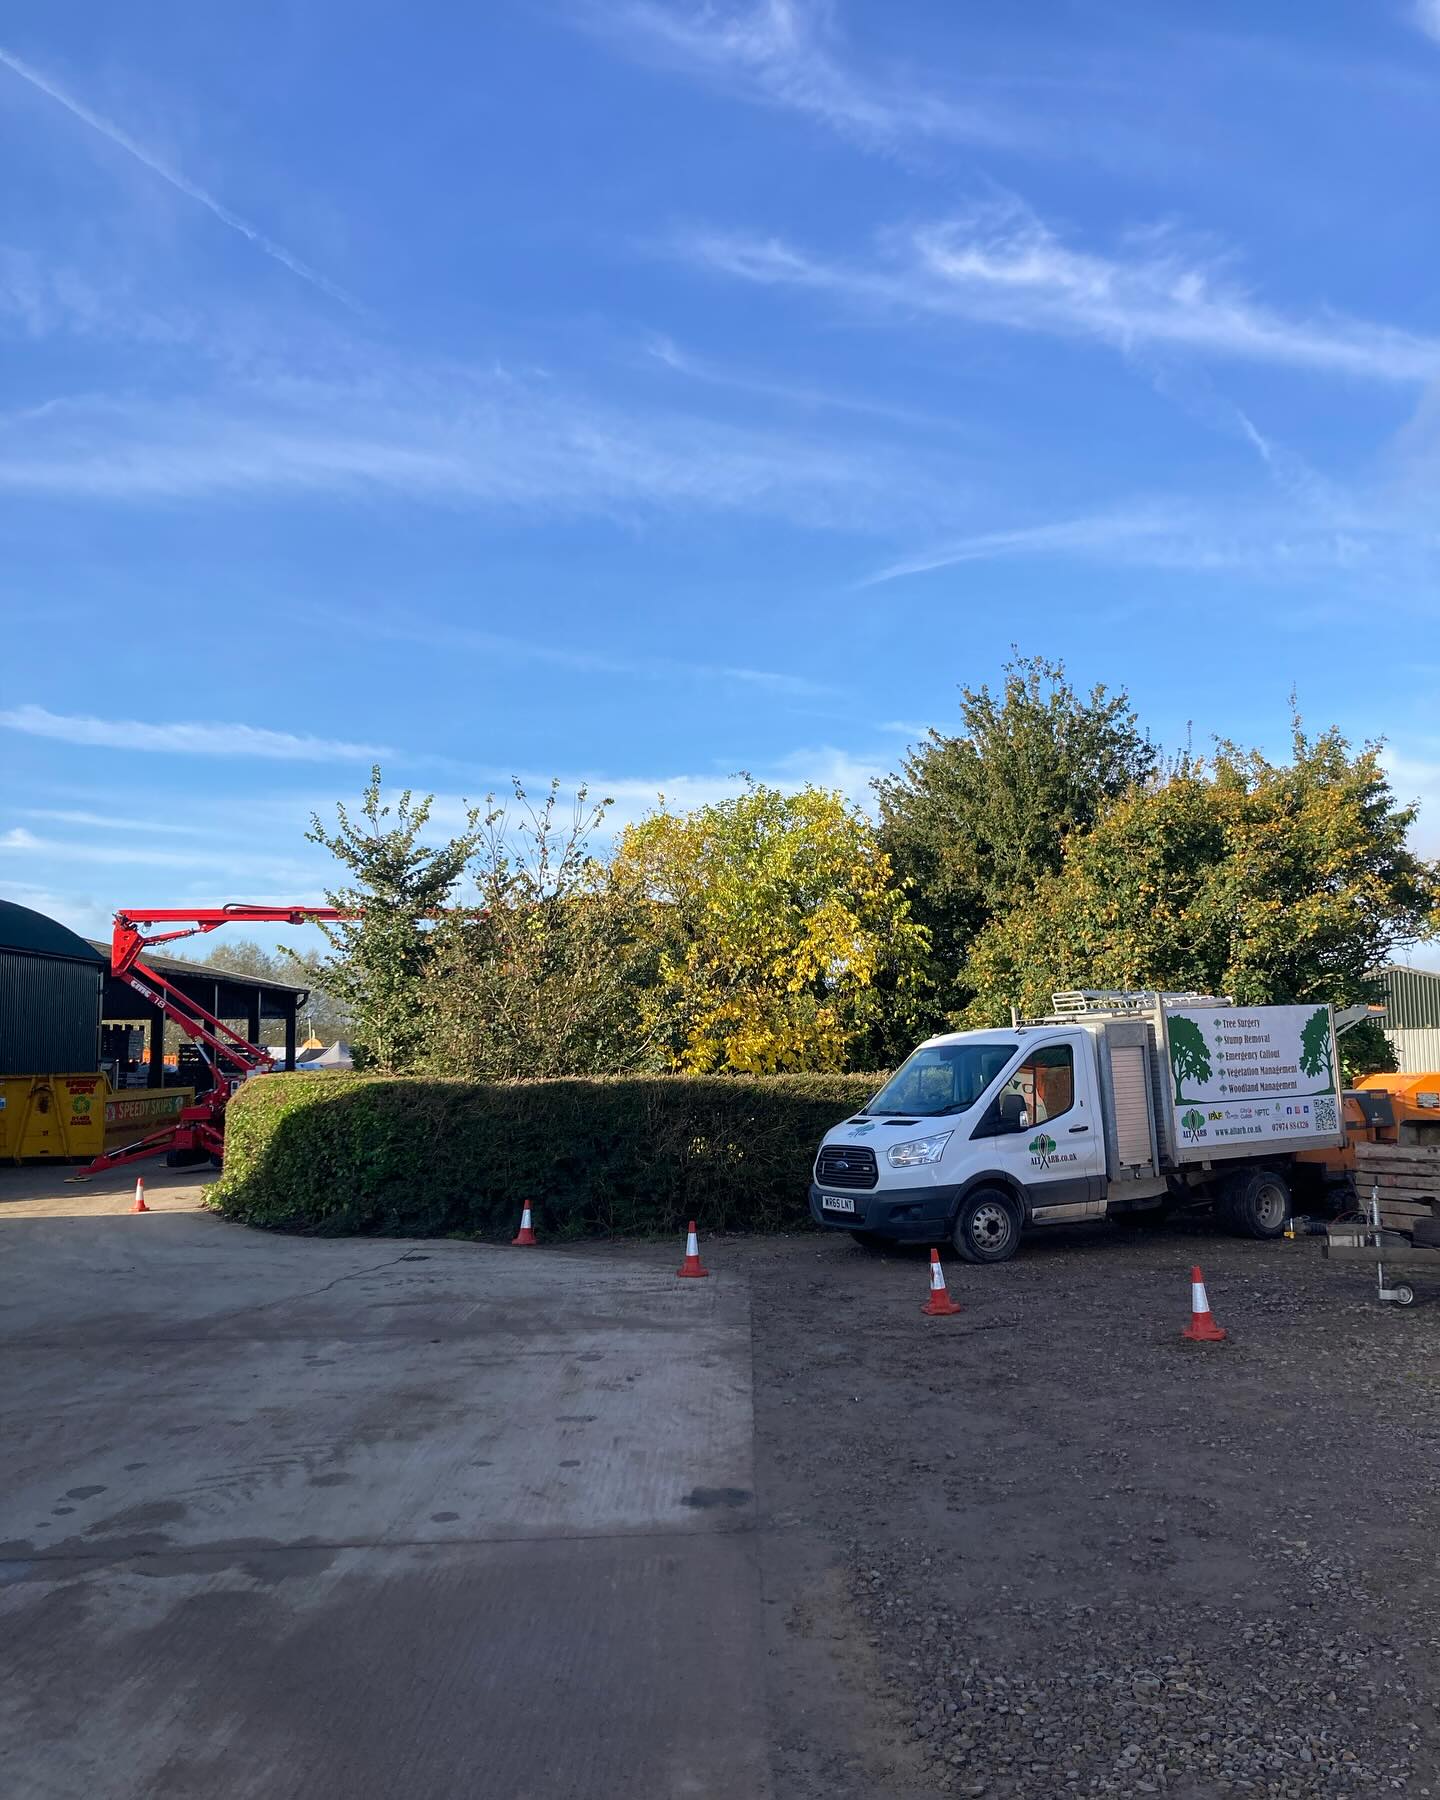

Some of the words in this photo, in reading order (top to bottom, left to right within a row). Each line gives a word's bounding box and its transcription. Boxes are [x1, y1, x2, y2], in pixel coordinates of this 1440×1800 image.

[154, 997, 166, 1008] 18
[1223, 1019, 1237, 1028] Tree
[1238, 1019, 1260, 1028] Surgery
[1224, 1036, 1243, 1045] Stump
[1244, 1034, 1270, 1043] Removal
[1225, 1051, 1258, 1061] Emergency
[1260, 1050, 1280, 1059] Callout
[1227, 1068, 1259, 1078] Vegetation
[1260, 1065, 1297, 1075] Management
[1228, 1083, 1259, 1093] Woodland
[1260, 1081, 1297, 1091] Management
[119, 1100, 149, 1119] SPEEDY
[151, 1098, 173, 1115] SKIPS
[1272, 1122, 1289, 1132] 07974
[824, 1197, 840, 1208] WR65
[841, 1199, 852, 1211] LNT
